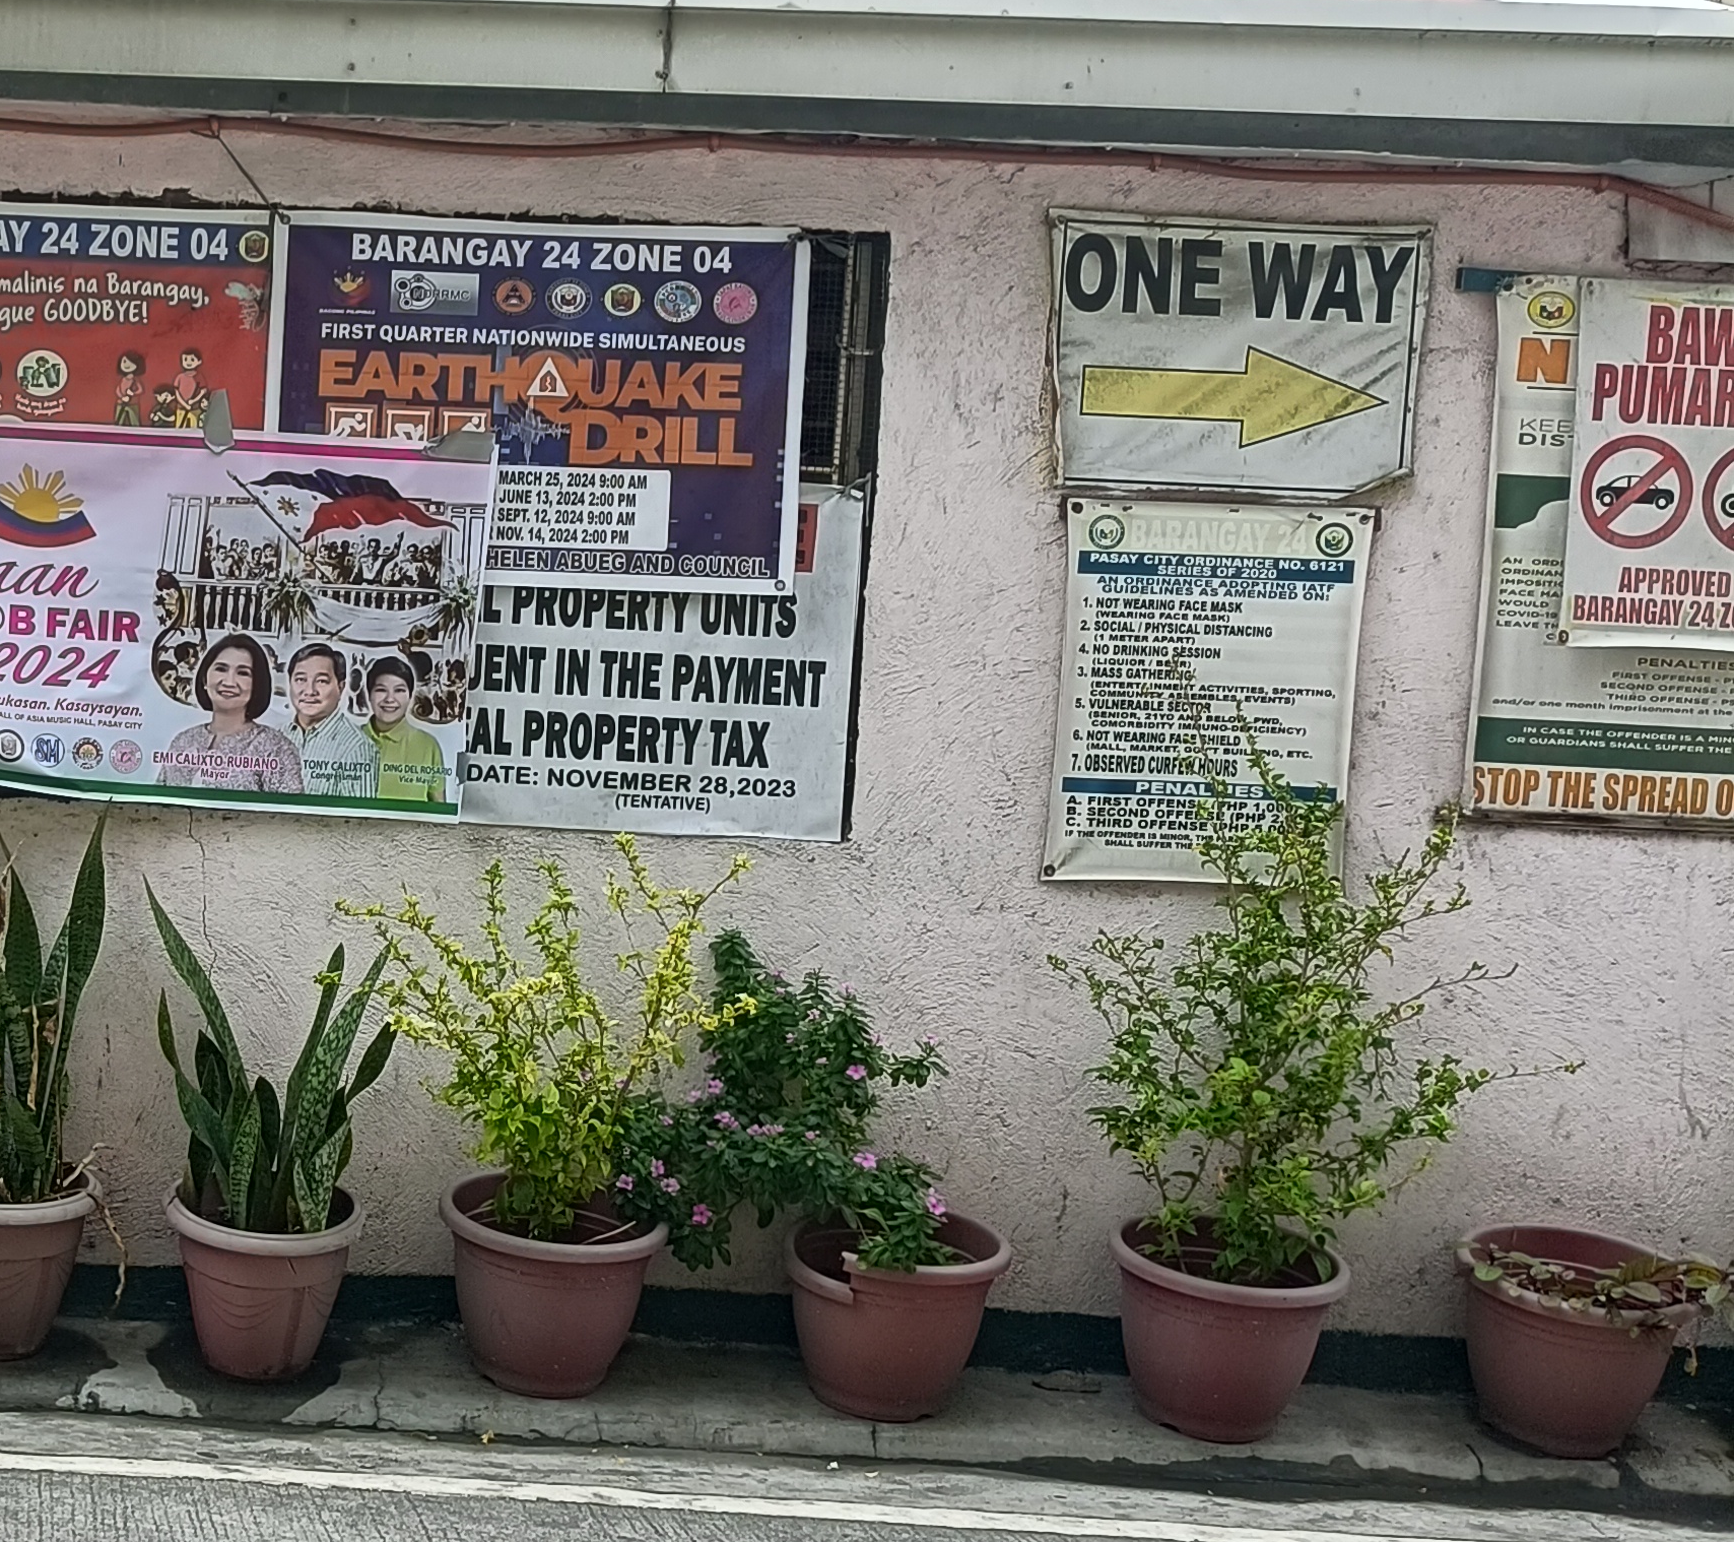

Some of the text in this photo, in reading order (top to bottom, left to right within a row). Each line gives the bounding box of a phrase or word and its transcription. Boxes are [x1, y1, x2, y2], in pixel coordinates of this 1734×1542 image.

[41, 222, 78, 255] 24
[89, 225, 179, 258] ZONE
[191, 227, 228, 261] 04
[351, 233, 732, 274] BARANGAY 24 ZONE 04
[73, 276, 98, 295] na
[106, 273, 210, 307] Barangay,
[1066, 232, 1415, 323] ONE WAY
[43, 298, 149, 325] GOODBYE!
[321, 323, 745, 352] FIRST QUARTER NATIONWIDE SIMULTANEOUS
[318, 349, 743, 422] EARTHQUAKE
[569, 409, 754, 467] DRILL
[499, 471, 647, 489] MARCH 25, 2024 9:00 AM
[499, 490, 636, 507] JUNE 13, 2024 2:00 PM
[497, 508, 635, 526] SEPT. 12, 2024 9:00 AM
[497, 527, 628, 544] NOV. 14, 2024 2:00 PM
[1131, 519, 1306, 555] BARANGAY 24
[486, 547, 770, 577] HELEN ABUEG AND COUNCIL
[1090, 553, 1344, 571] PASAY CITY ORDINANCE NO. 6121
[1157, 566, 1277, 579] SERIES OF 2020
[1618, 567, 1731, 598] APPROVED
[478, 586, 797, 638] L PROPERTY UNITS
[1083, 597, 1243, 613] 1. NOT WEARING FACE MASK
[1573, 595, 1714, 628] BARANGAY 24
[46, 607, 141, 643] FAIR
[1080, 620, 1090, 631] 2.
[1094, 621, 1135, 632] SOCIAL
[1144, 622, 1200, 635] PHYSICAL
[1204, 625, 1272, 637] DISTANCING
[1079, 643, 1221, 658] 4. NO DRINKING SESSION
[554, 648, 590, 696] IN
[600, 651, 663, 700] THE
[671, 654, 826, 708] PAYMENT
[54, 698, 143, 718] Kasaysayan.
[522, 711, 703, 765] PROPERTY
[710, 720, 770, 768] TAX
[1540, 727, 1574, 735] CASE
[1607, 730, 1676, 741] OFFENDER
[154, 752, 173, 763] EMI
[304, 760, 371, 773] TONY CALIXTO
[384, 763, 403, 773] DING
[200, 768, 229, 779] Mayor
[466, 764, 796, 797] DATE: NOVEMBER 28,2023
[614, 794, 711, 814] (TENTATIVE)
[1473, 765, 1708, 816] STOP THE SPREAD
